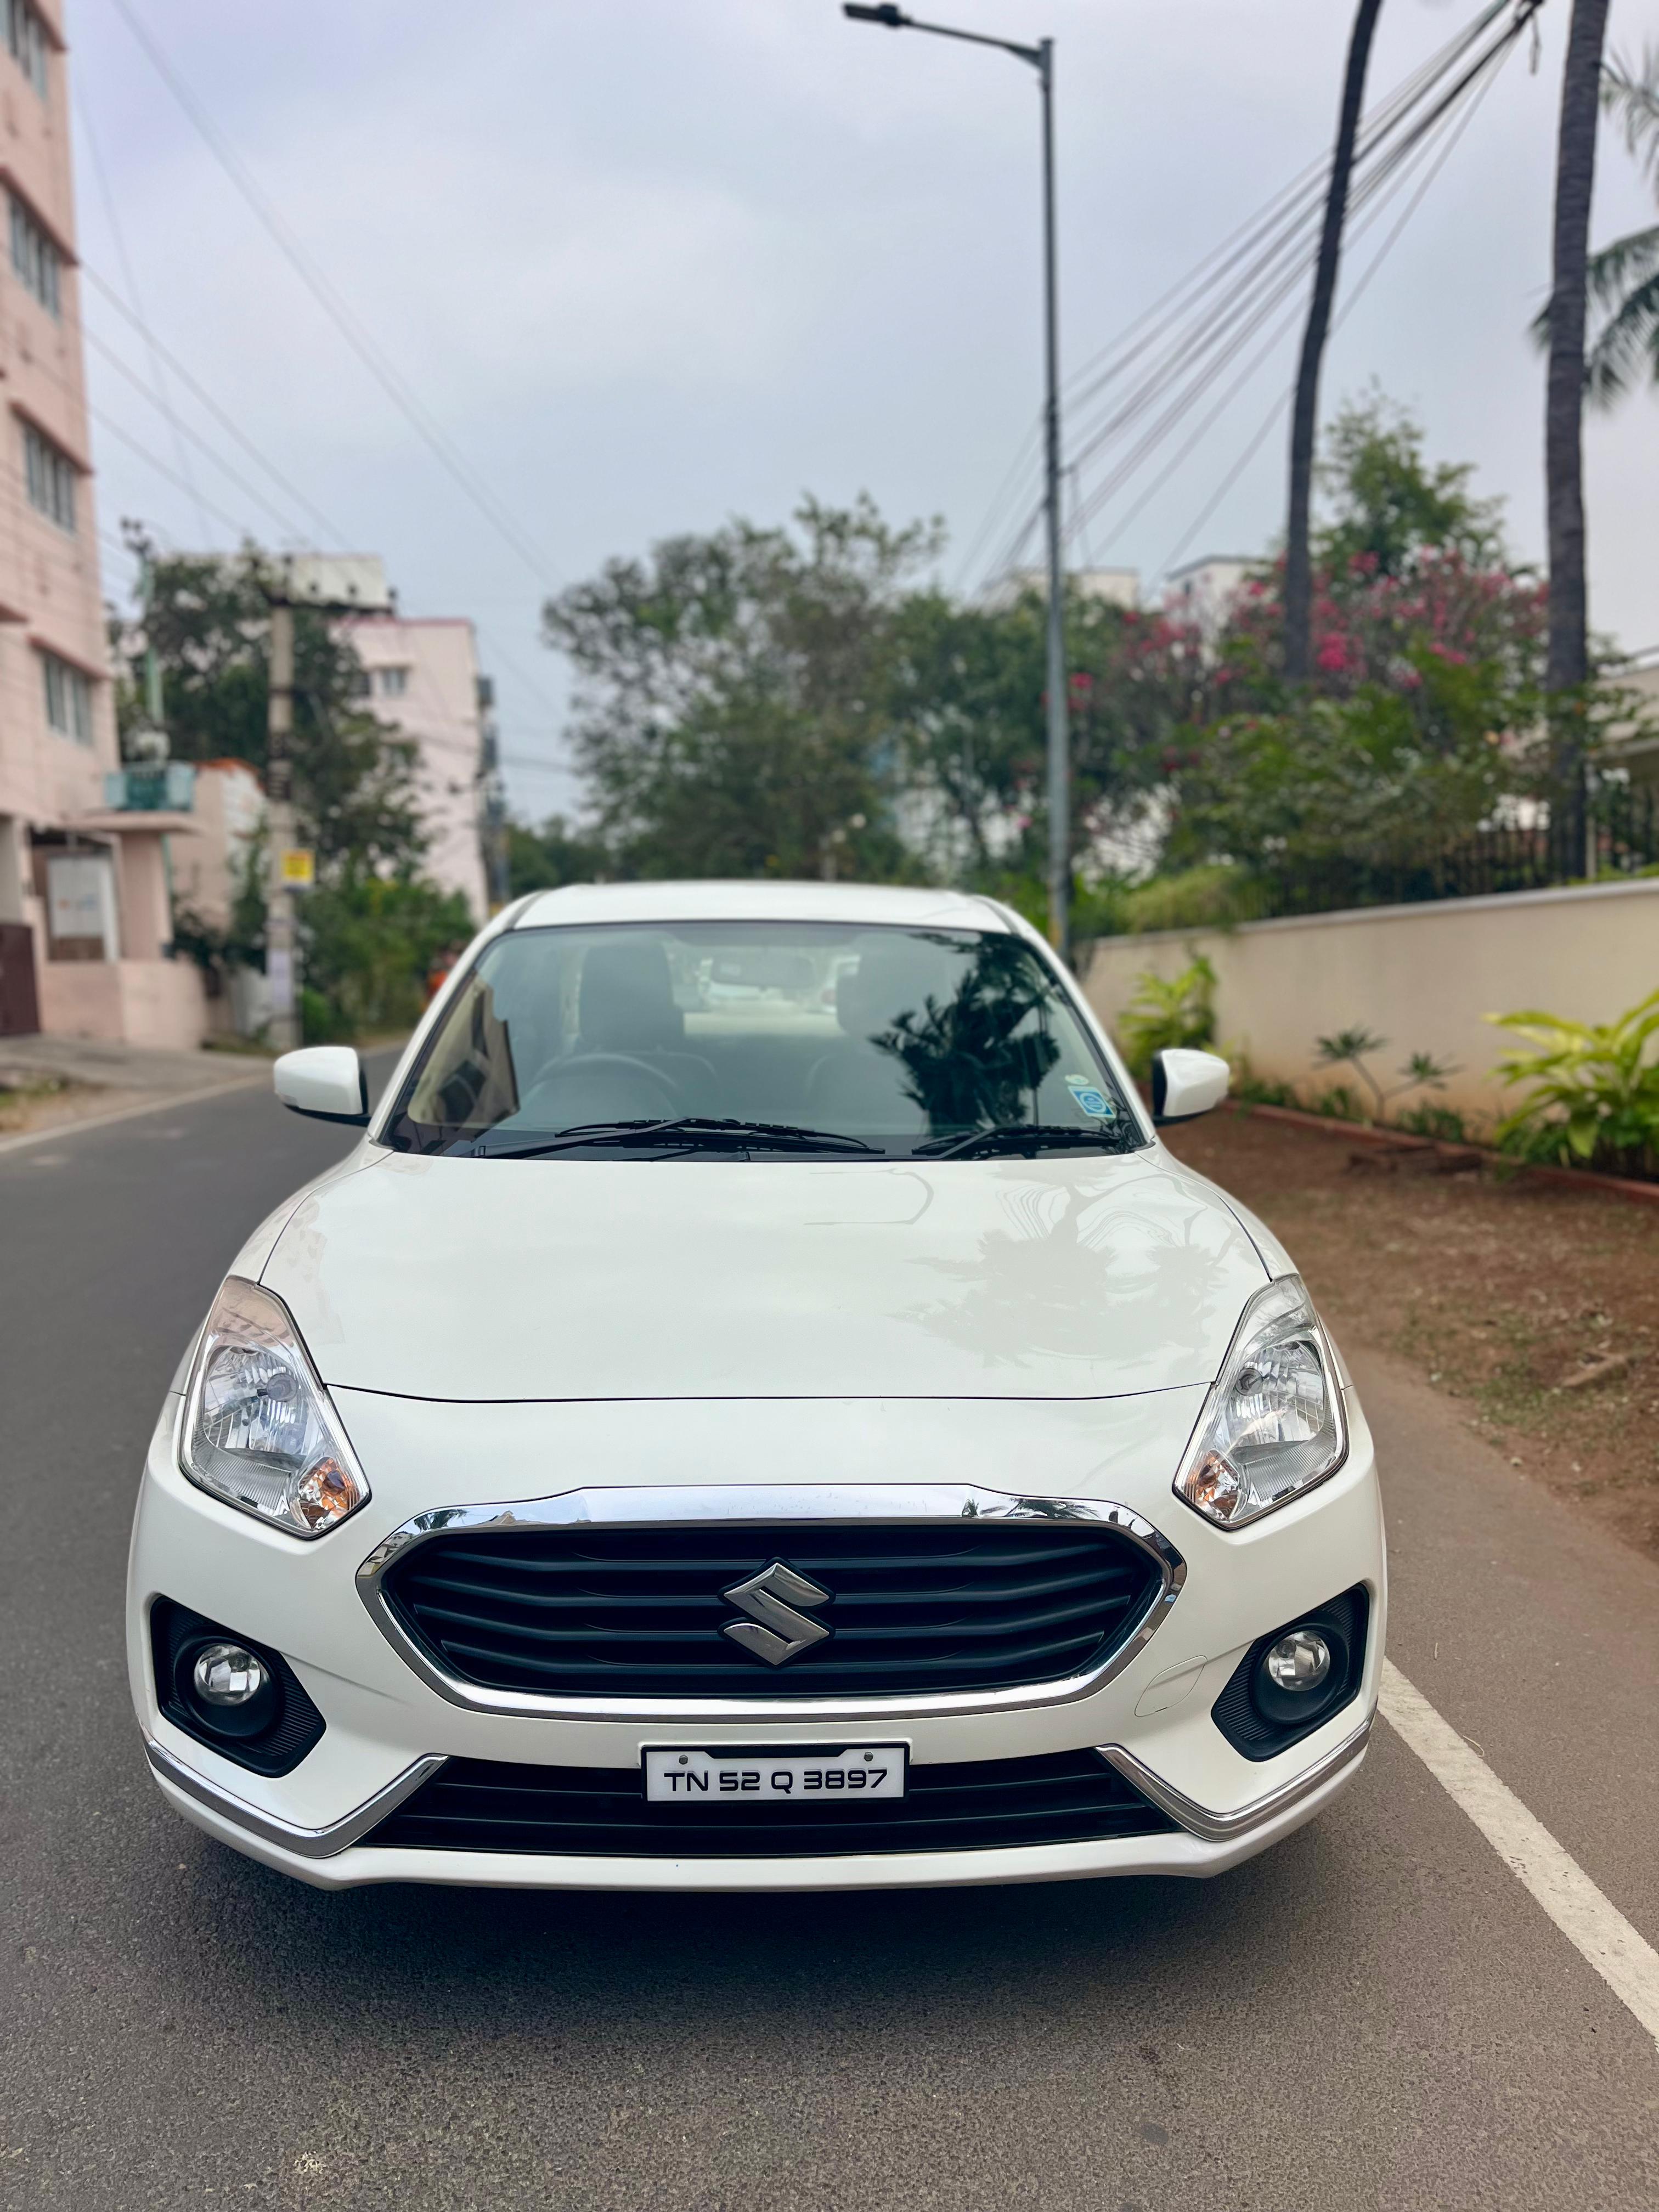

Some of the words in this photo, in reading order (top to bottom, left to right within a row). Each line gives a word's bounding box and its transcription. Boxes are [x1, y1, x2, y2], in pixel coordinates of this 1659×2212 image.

[664, 1770, 709, 1792] TN
[719, 1772, 760, 1791] 52
[771, 1771, 793, 1795] Q
[804, 1769, 888, 1790] 3897
